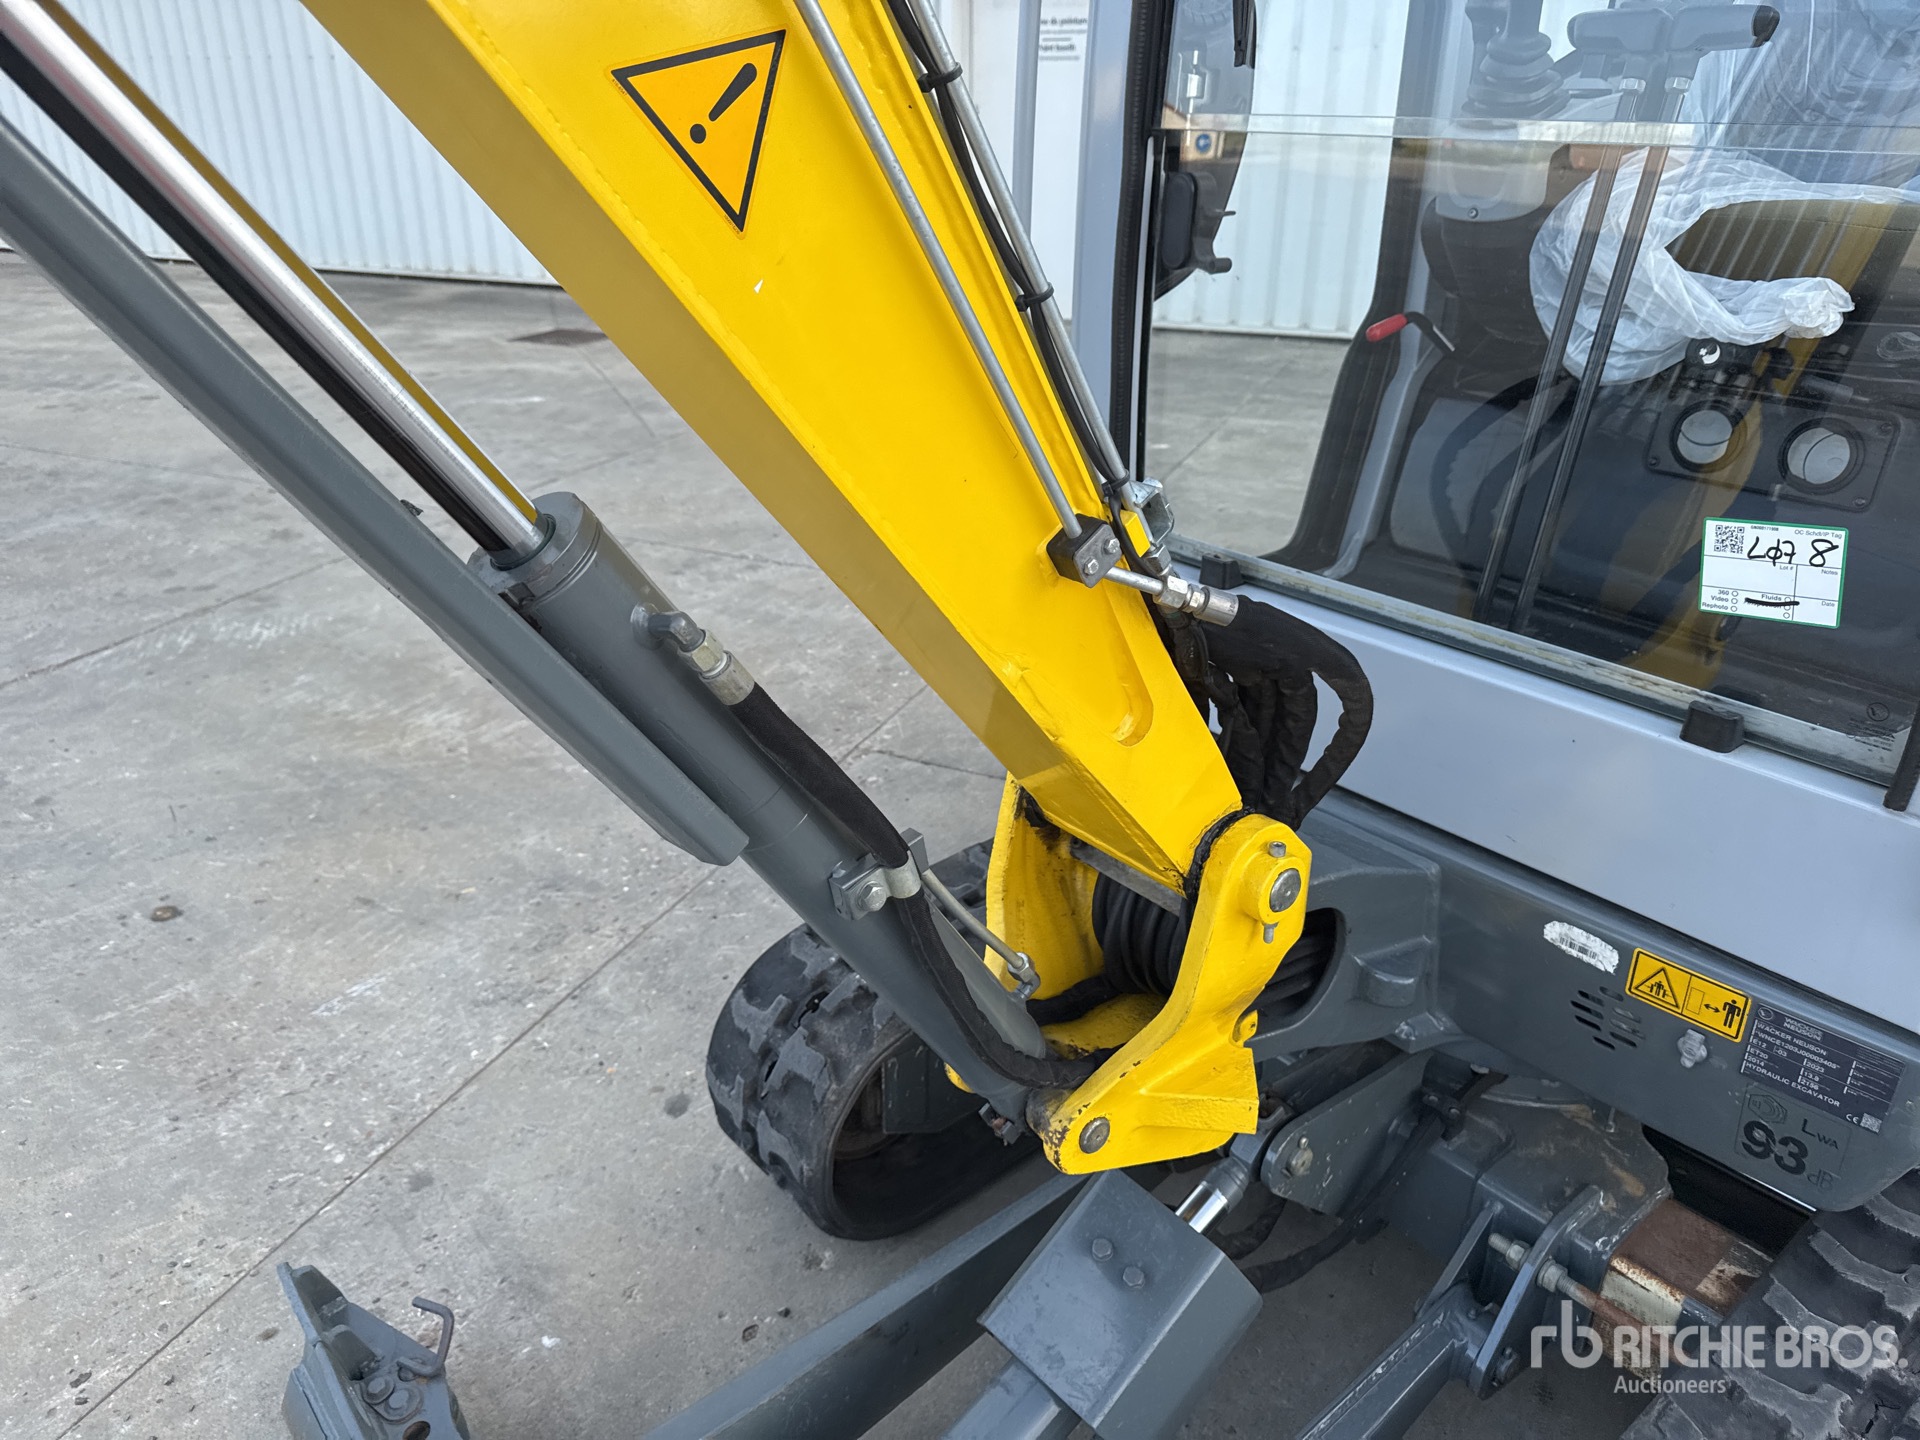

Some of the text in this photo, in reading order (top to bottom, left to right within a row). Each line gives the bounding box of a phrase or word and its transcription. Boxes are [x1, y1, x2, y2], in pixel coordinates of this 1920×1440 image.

[1832, 532, 1843, 540] Tag
[1821, 568, 1838, 576] Notes
[1710, 595, 1729, 603] Video
[1761, 593, 1782, 602] Fluids
[1701, 602, 1729, 611] Rephoto
[1782, 1021, 1821, 1042] NEUSON
[1783, 1016, 1823, 1037] WACKER
[1756, 1022, 1827, 1056] WACKER NEUSON
[1749, 1047, 1769, 1060] ET20
[1751, 1037, 1767, 1048] E12
[1805, 1060, 1826, 1073] 2023
[1747, 1055, 1765, 1067] 2014
[1745, 1061, 1790, 1085] HYDRAULIC
[1790, 1080, 1841, 1108] EXCAVATOR
[1741, 1120, 1834, 1193] 93 dB
